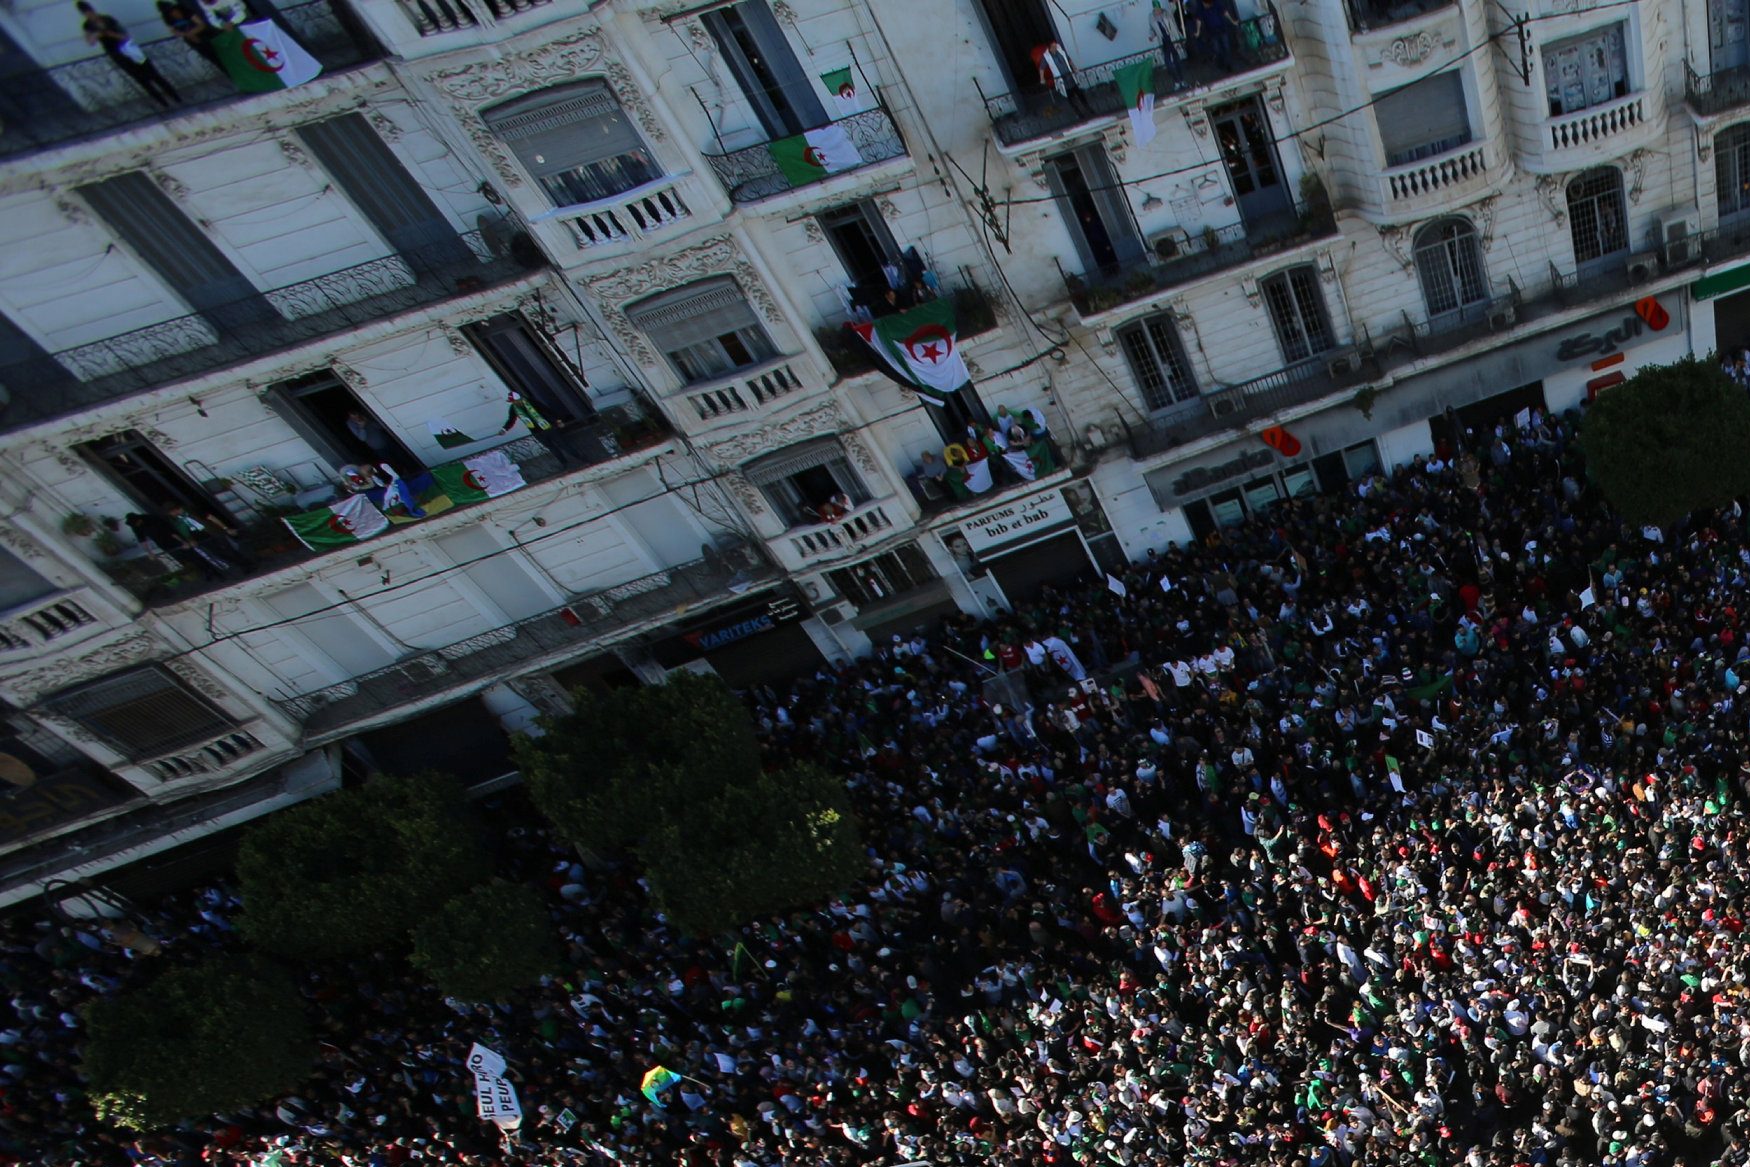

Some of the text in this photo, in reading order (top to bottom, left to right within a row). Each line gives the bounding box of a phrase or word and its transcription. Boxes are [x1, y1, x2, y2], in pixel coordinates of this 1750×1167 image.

[1020, 492, 1056, 513] عطور
[964, 507, 1016, 530] PARFUMS
[1011, 520, 1023, 530] et
[1024, 509, 1049, 525] bab
[698, 614, 773, 649] VARITEKS
[495, 1076, 514, 1112] PEUP
